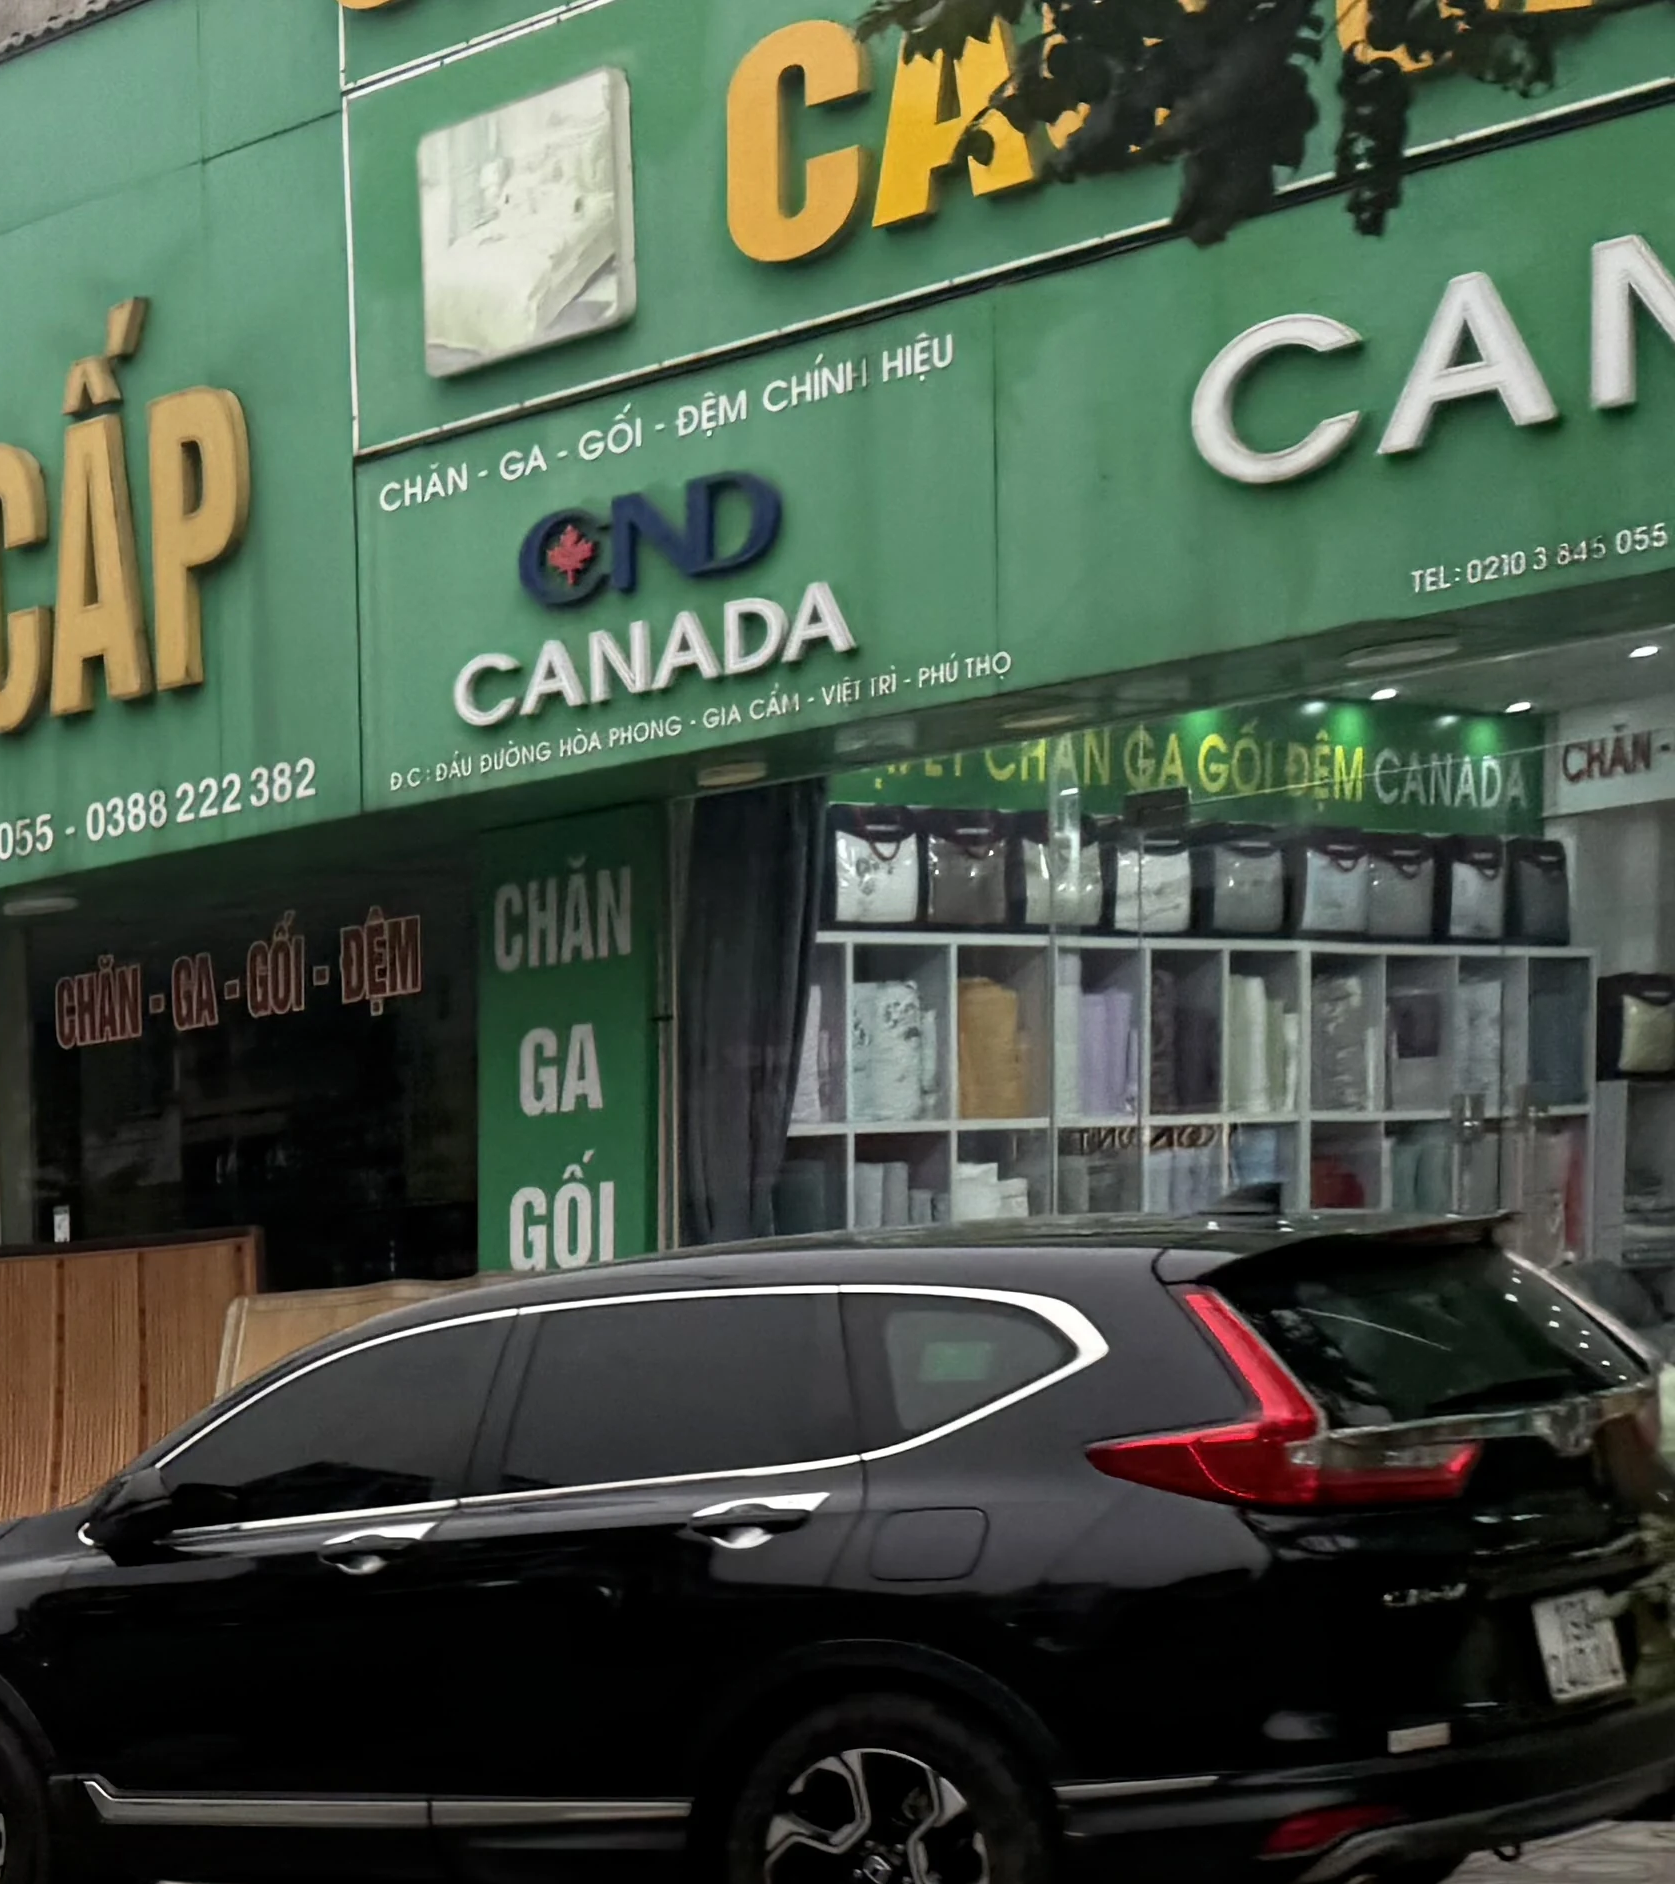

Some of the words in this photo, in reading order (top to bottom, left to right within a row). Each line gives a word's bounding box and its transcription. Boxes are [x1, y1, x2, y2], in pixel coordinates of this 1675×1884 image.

[379, 462, 469, 512] CHĂN
[499, 444, 547, 483] GA
[578, 402, 643, 462] GỐI
[676, 390, 748, 440] ĐỆM
[761, 354, 868, 413] CHÍNH
[882, 333, 954, 387] HIỆU
[1467, 551, 1527, 584] 0210
[1533, 546, 1548, 571] 3
[1557, 536, 1607, 565] 845
[1616, 522, 1669, 554] 055
[454, 580, 858, 729] CANADA
[479, 738, 551, 777] ĐƯỜNG
[559, 727, 602, 758] HÒA
[608, 715, 682, 748] PHONG
[702, 703, 742, 729] GIA
[821, 676, 861, 707] VIỆT
[869, 664, 899, 698] TRÌ
[917, 653, 959, 689] PHÚ
[964, 651, 1012, 681] THỌ
[86, 789, 168, 842] 0388
[175, 772, 243, 823] 222
[249, 756, 317, 808] 382
[1123, 733, 1186, 790] GA
[1284, 728, 1364, 812] ĐỆM
[1374, 748, 1527, 809] CANADA
[494, 856, 633, 972] CHĂN
[55, 953, 142, 1049] CHĂN
[171, 952, 219, 1032] GA
[247, 909, 305, 1018] GỐI
[340, 905, 422, 1017] ĐỆM
[518, 1021, 603, 1118] GA
[508, 1148, 616, 1273] GỐI
